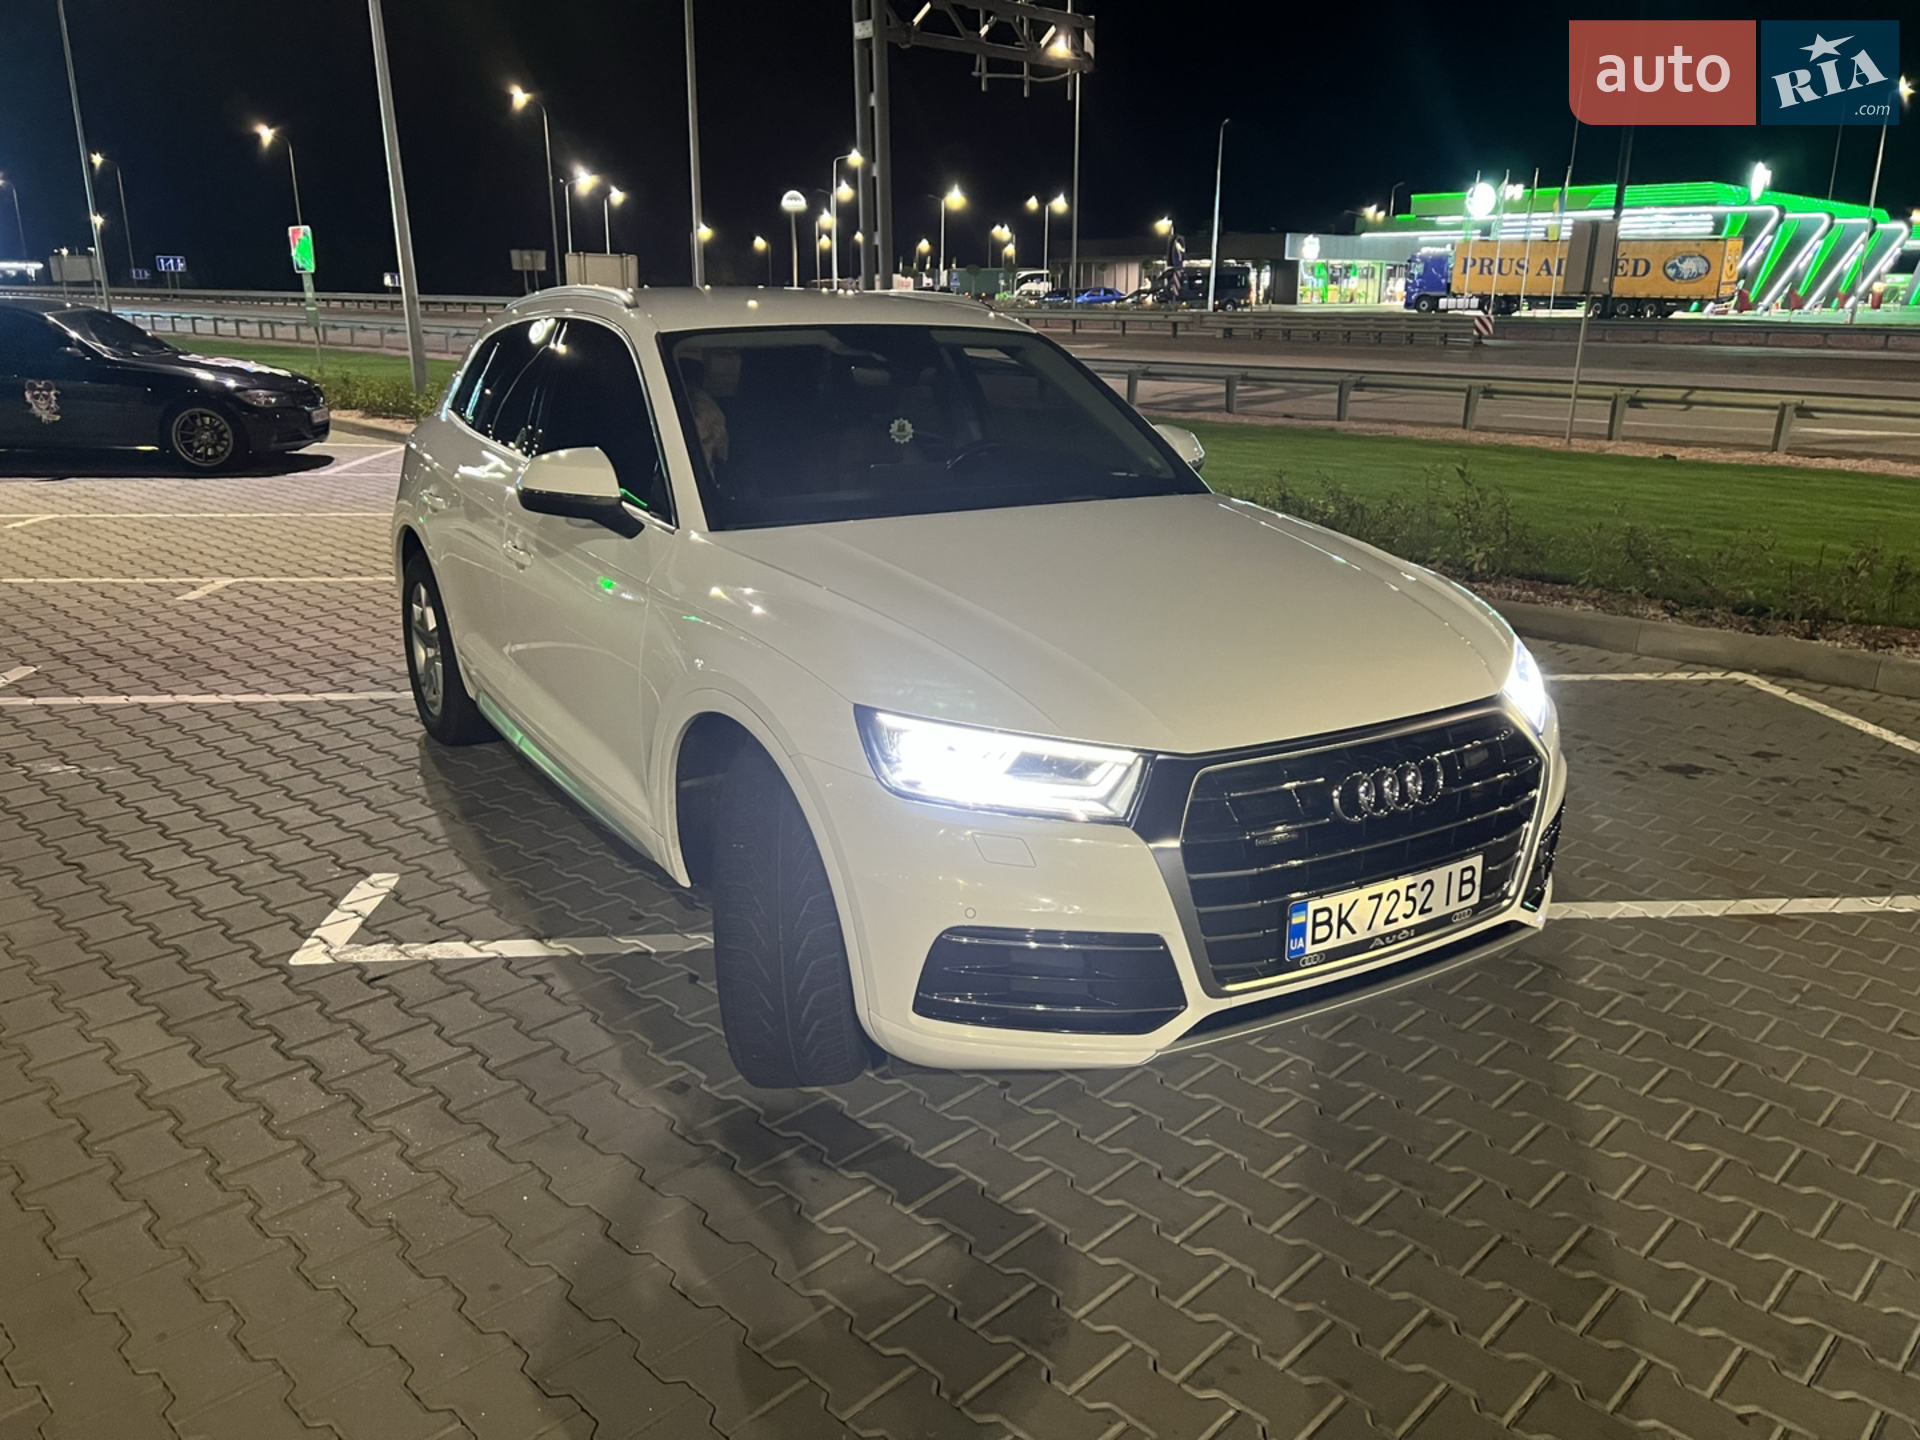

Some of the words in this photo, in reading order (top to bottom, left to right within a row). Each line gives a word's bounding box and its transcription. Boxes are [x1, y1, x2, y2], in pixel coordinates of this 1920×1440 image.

[1460, 256, 1530, 276] PRUS
[1311, 899, 1359, 945] BK
[1366, 879, 1435, 931] 7252
[1445, 865, 1477, 907] IB
[1290, 938, 1305, 950] UA
